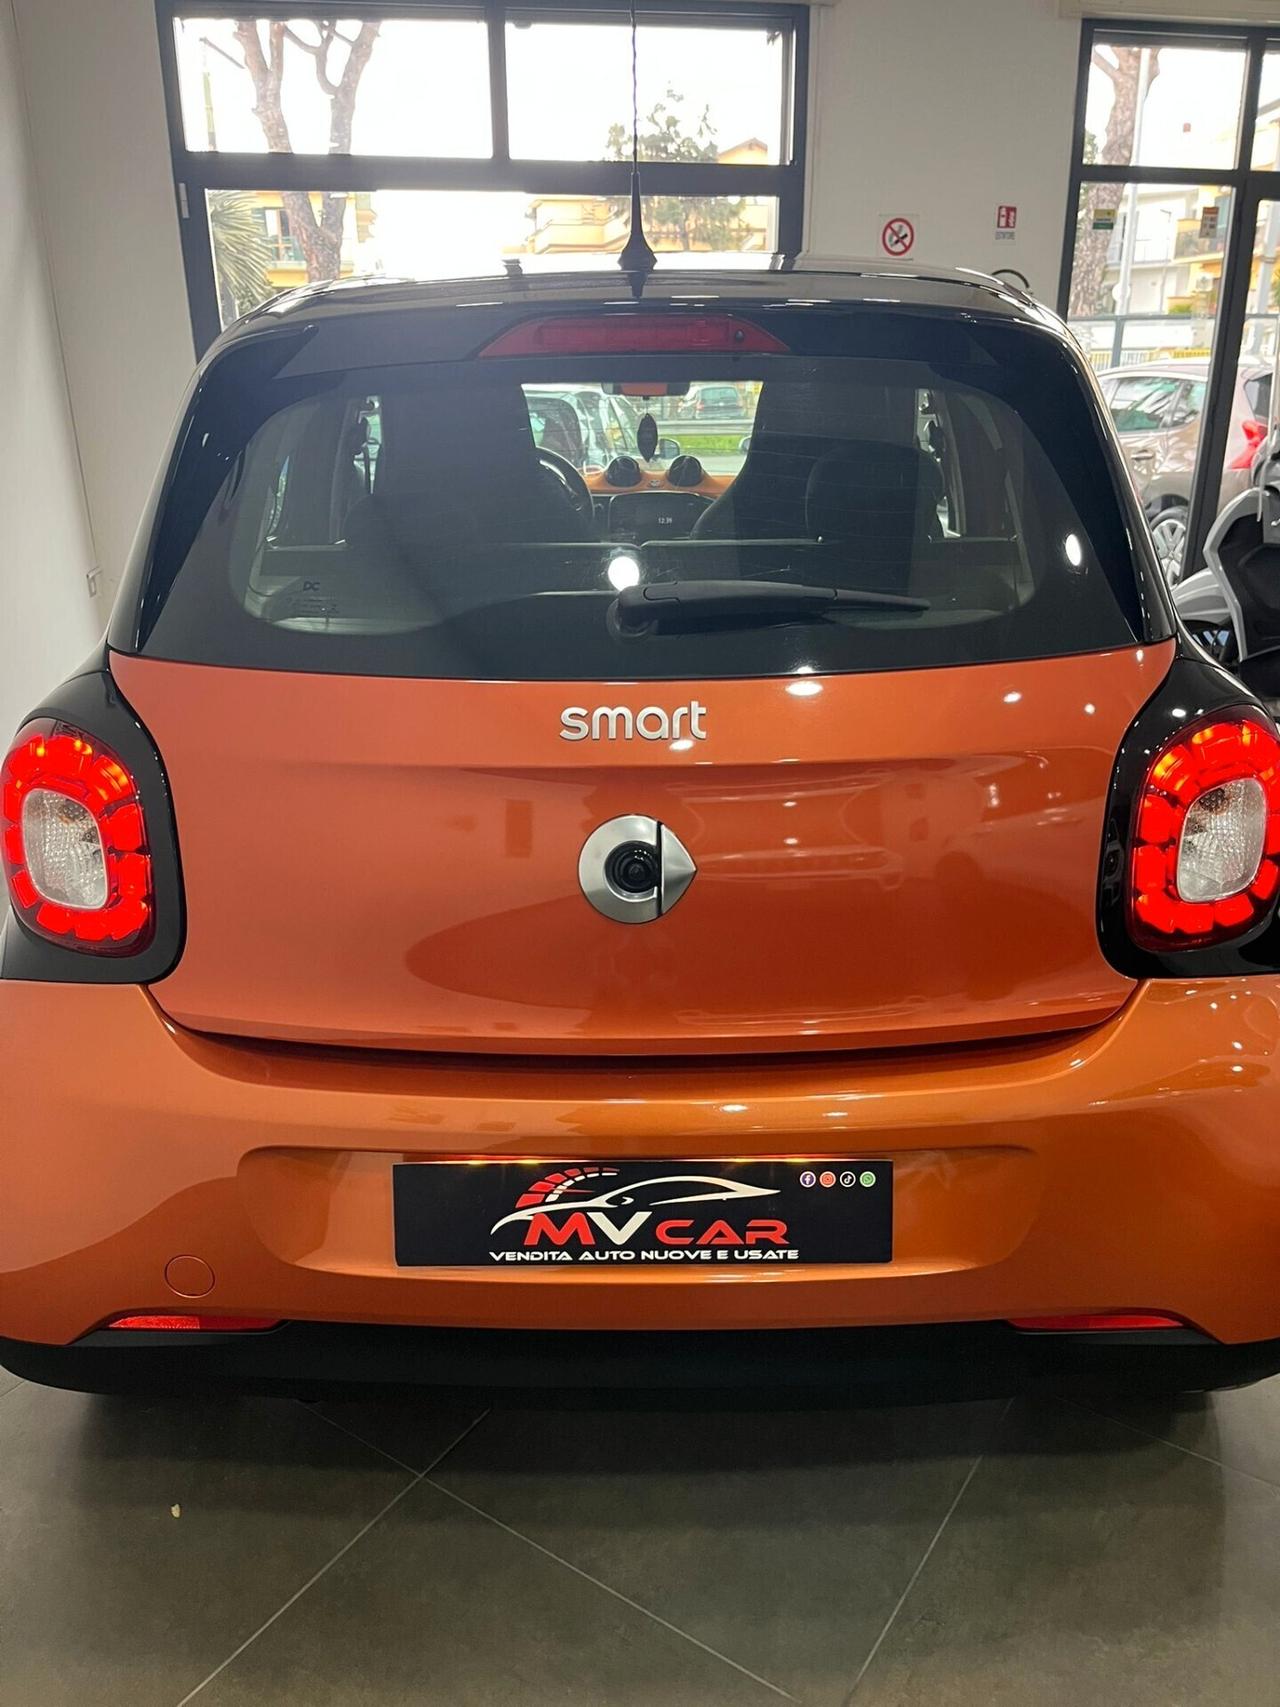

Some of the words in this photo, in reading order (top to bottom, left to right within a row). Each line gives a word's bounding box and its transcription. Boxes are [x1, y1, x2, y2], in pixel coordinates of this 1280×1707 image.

[559, 700, 707, 741] smart
[489, 1250, 573, 1262] VENDITA
[578, 1250, 636, 1261] AUTO
[641, 1250, 712, 1261] NUOVE
[717, 1250, 728, 1260] E
[734, 1249, 799, 1260] USATE
